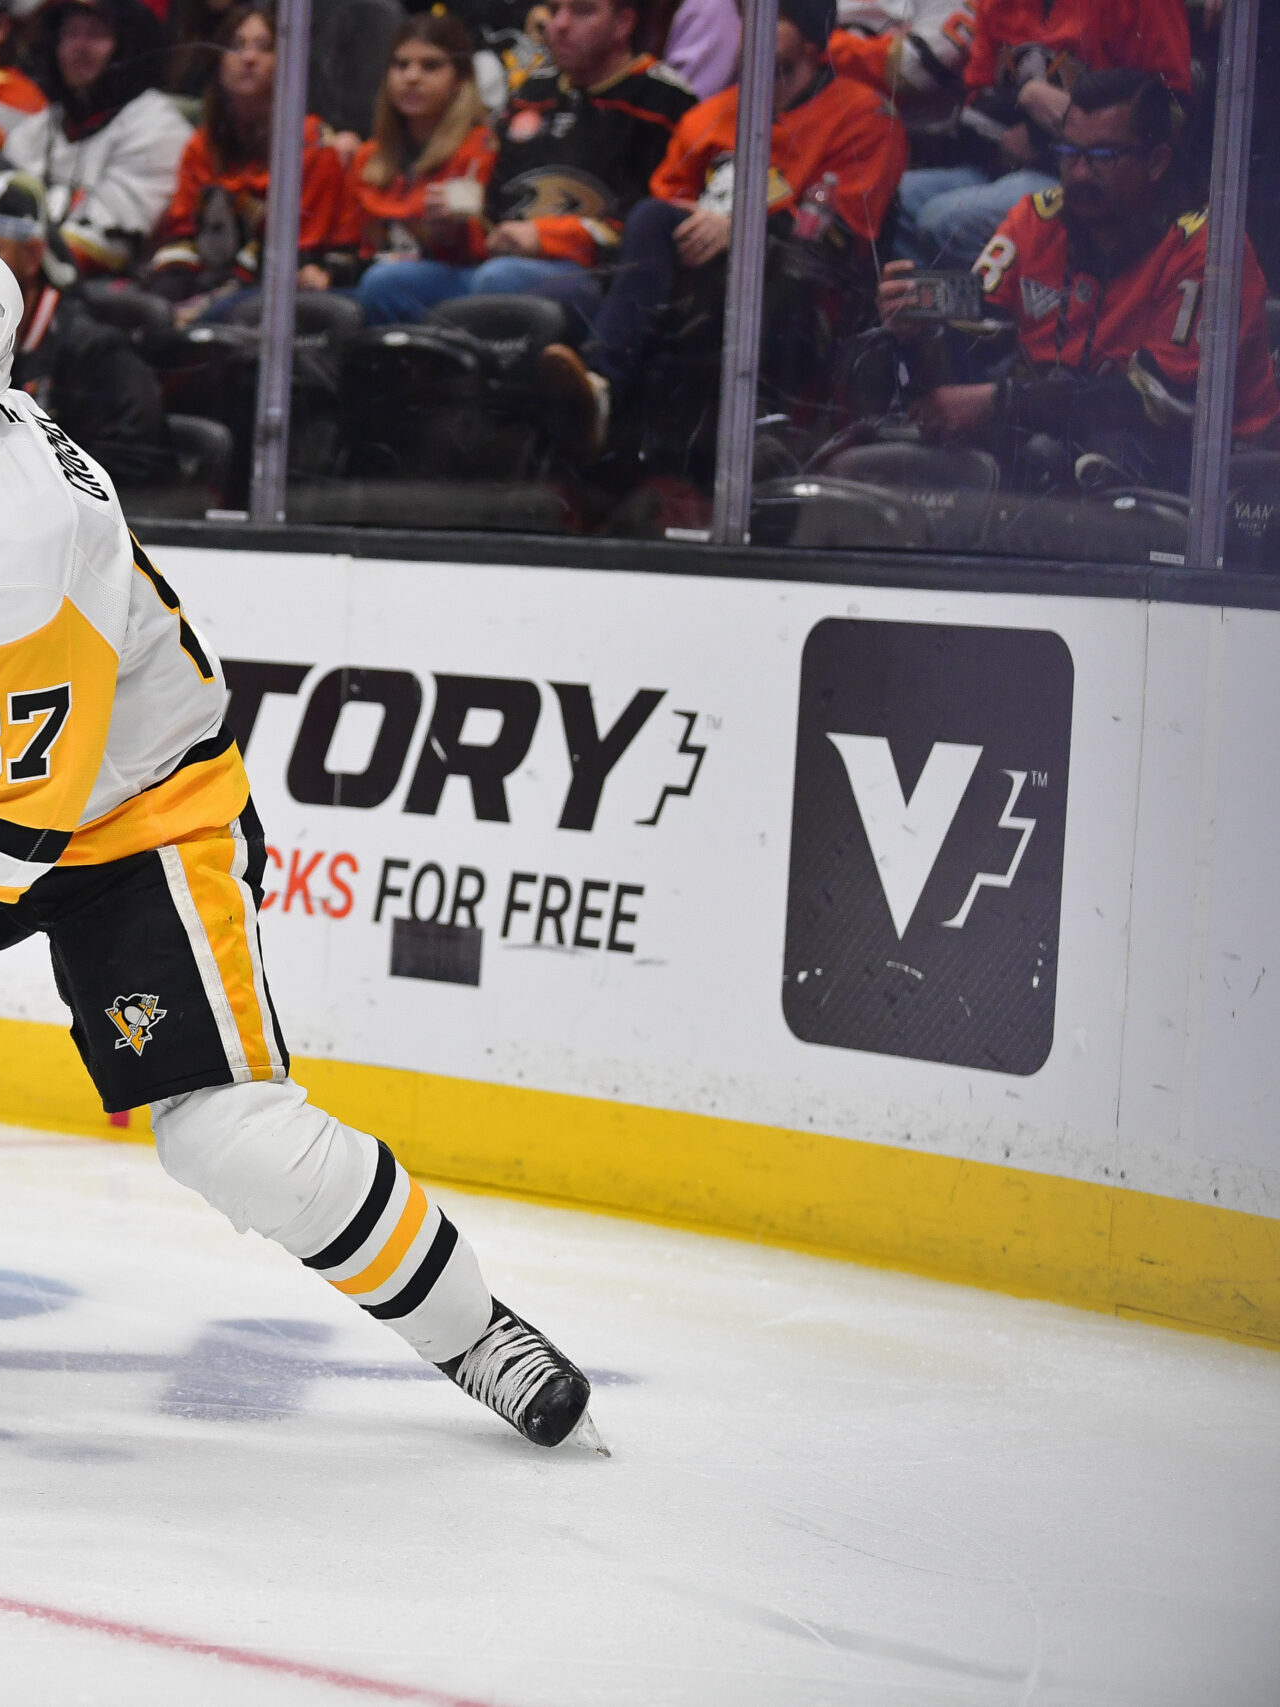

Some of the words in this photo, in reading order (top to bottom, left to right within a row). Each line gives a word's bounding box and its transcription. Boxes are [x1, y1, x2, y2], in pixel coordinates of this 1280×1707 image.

[220, 657, 669, 832] TORY
[259, 845, 359, 920] CKS
[373, 857, 486, 927] FOR
[500, 871, 645, 954] FREE
